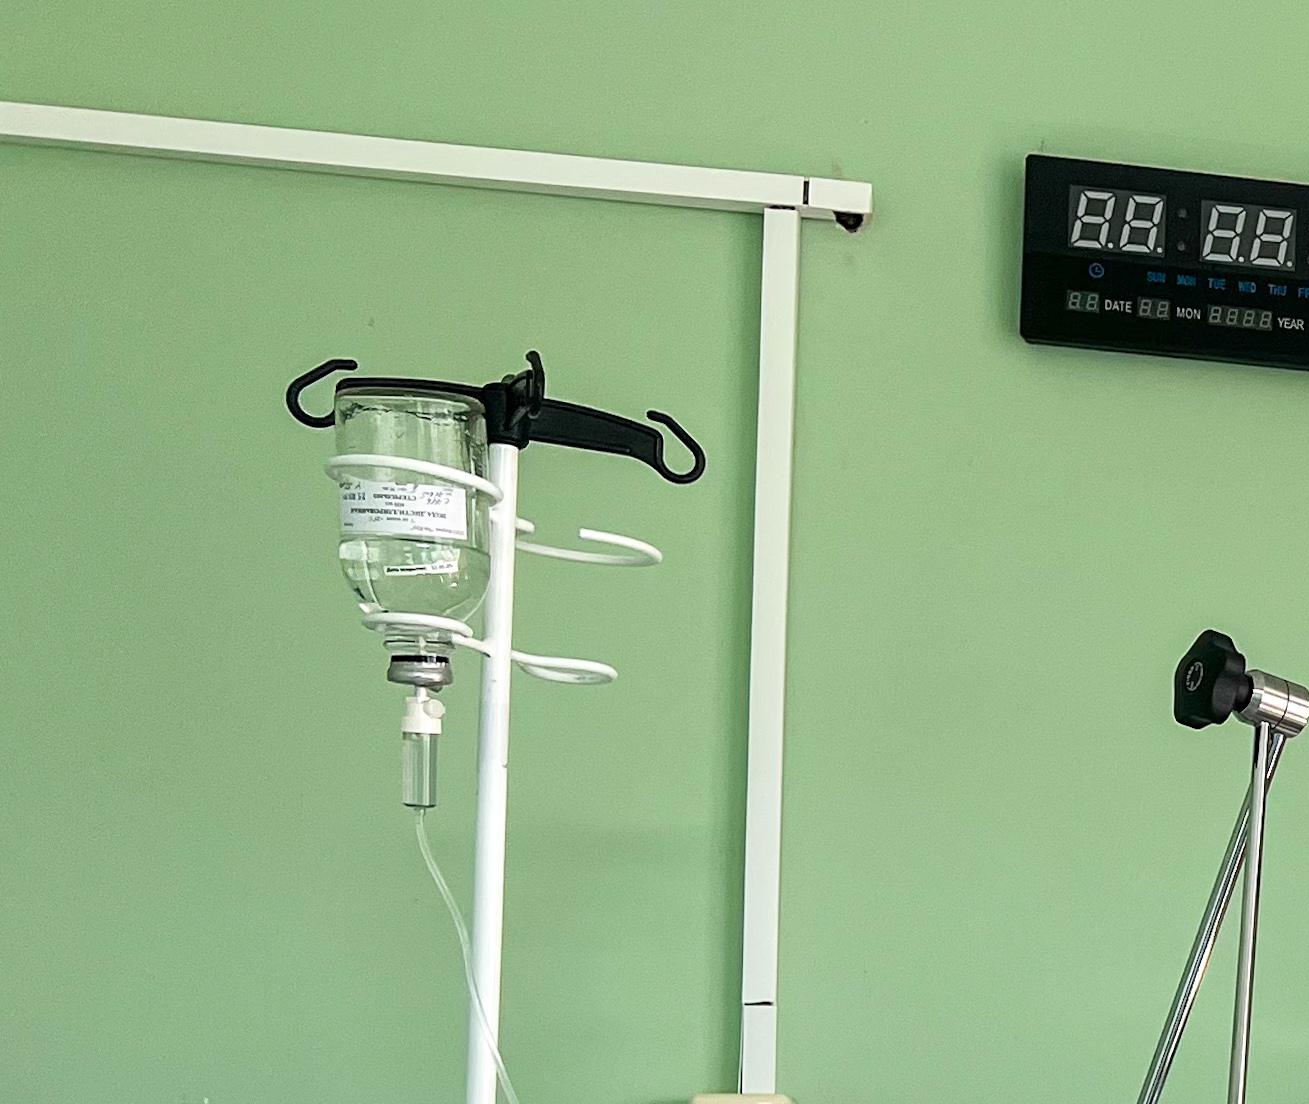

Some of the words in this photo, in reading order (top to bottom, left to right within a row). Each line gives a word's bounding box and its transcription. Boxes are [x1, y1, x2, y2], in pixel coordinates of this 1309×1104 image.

[1208, 277, 1227, 291] TUE
[1238, 281, 1257, 294] WED
[1267, 283, 1287, 297] THU
[1104, 299, 1133, 314] DATE
[1176, 306, 1201, 320] MON
[1277, 317, 1305, 332] YEAR
